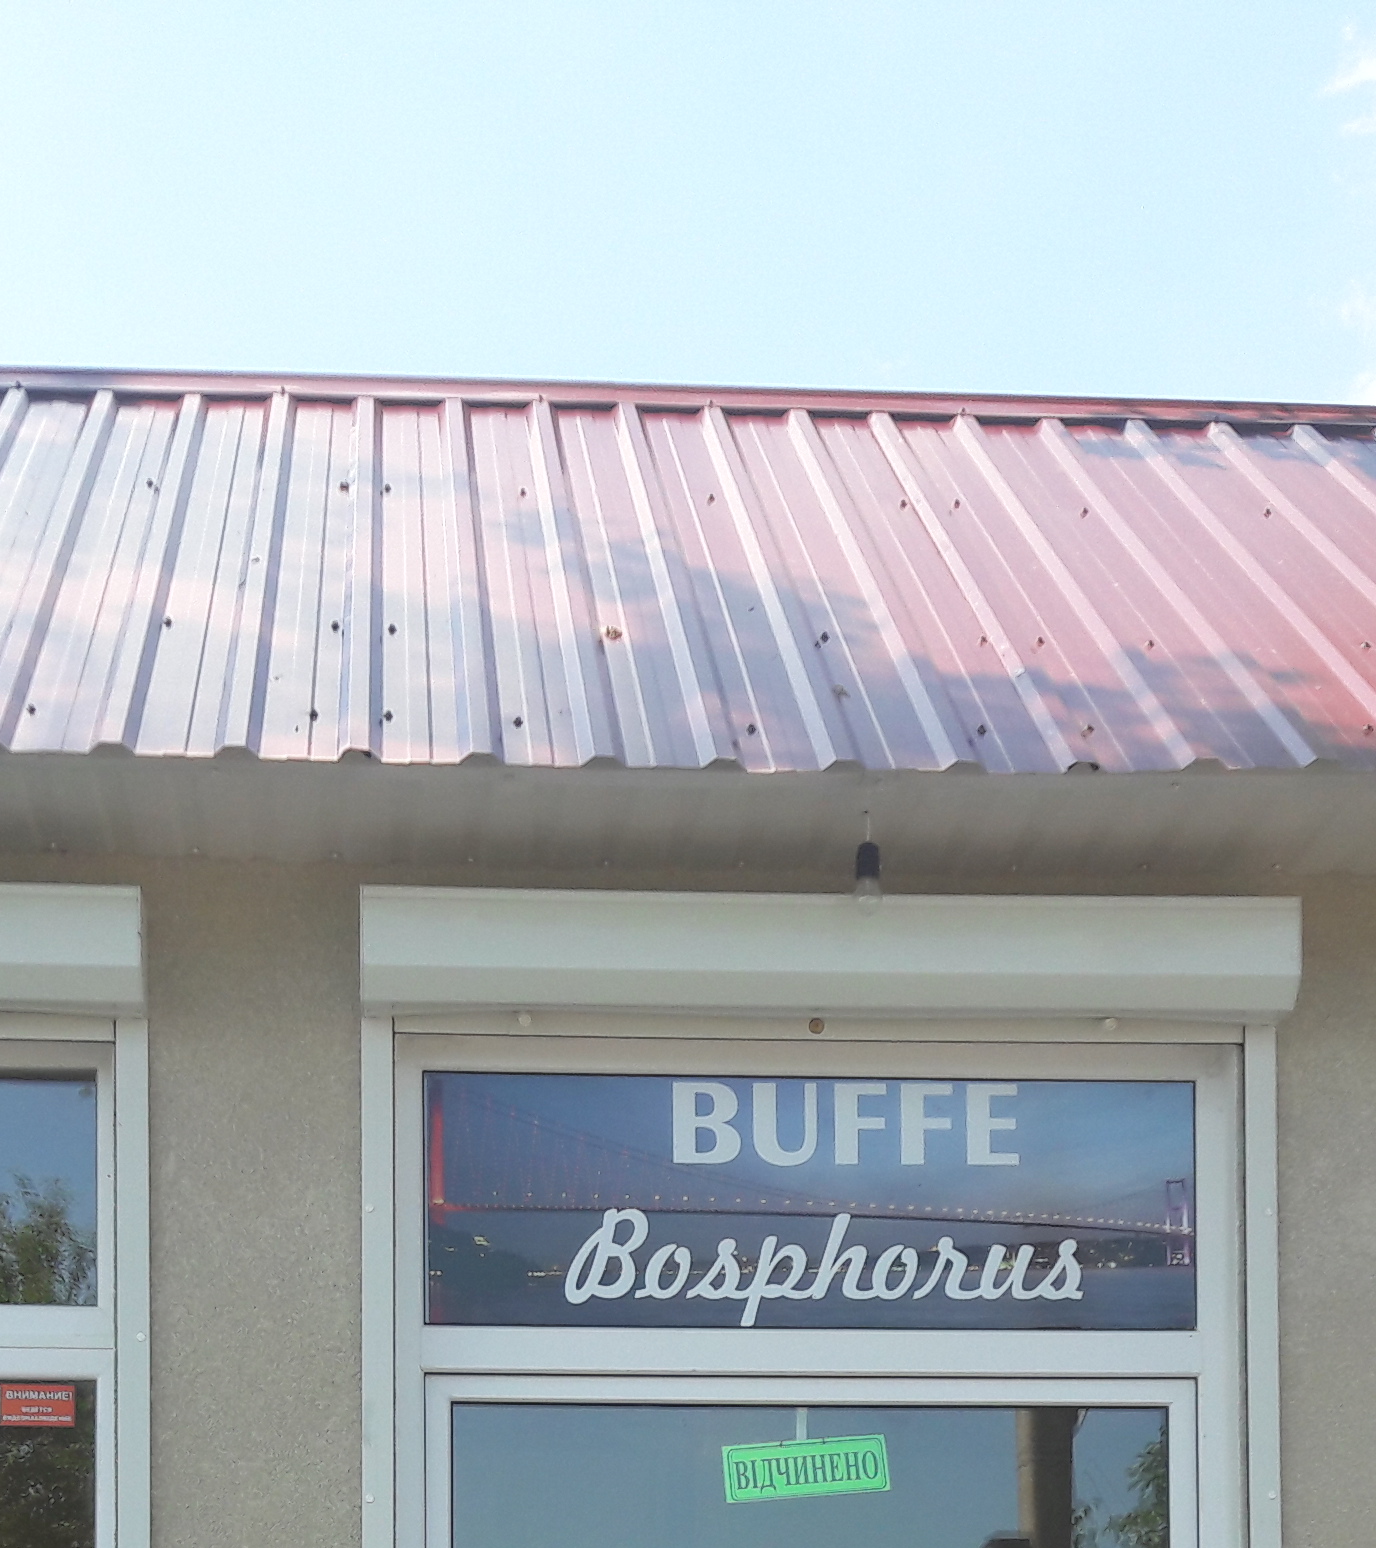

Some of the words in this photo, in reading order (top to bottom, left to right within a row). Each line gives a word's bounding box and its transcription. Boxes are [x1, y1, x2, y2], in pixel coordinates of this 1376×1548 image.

[670, 1081, 1021, 1167] BUFFE
[564, 1207, 1085, 1327] Bosphorus
[5, 1390, 73, 1400] ВНИМАНИЕ!
[734, 1447, 880, 1494] ВІДЧИНЕНО
